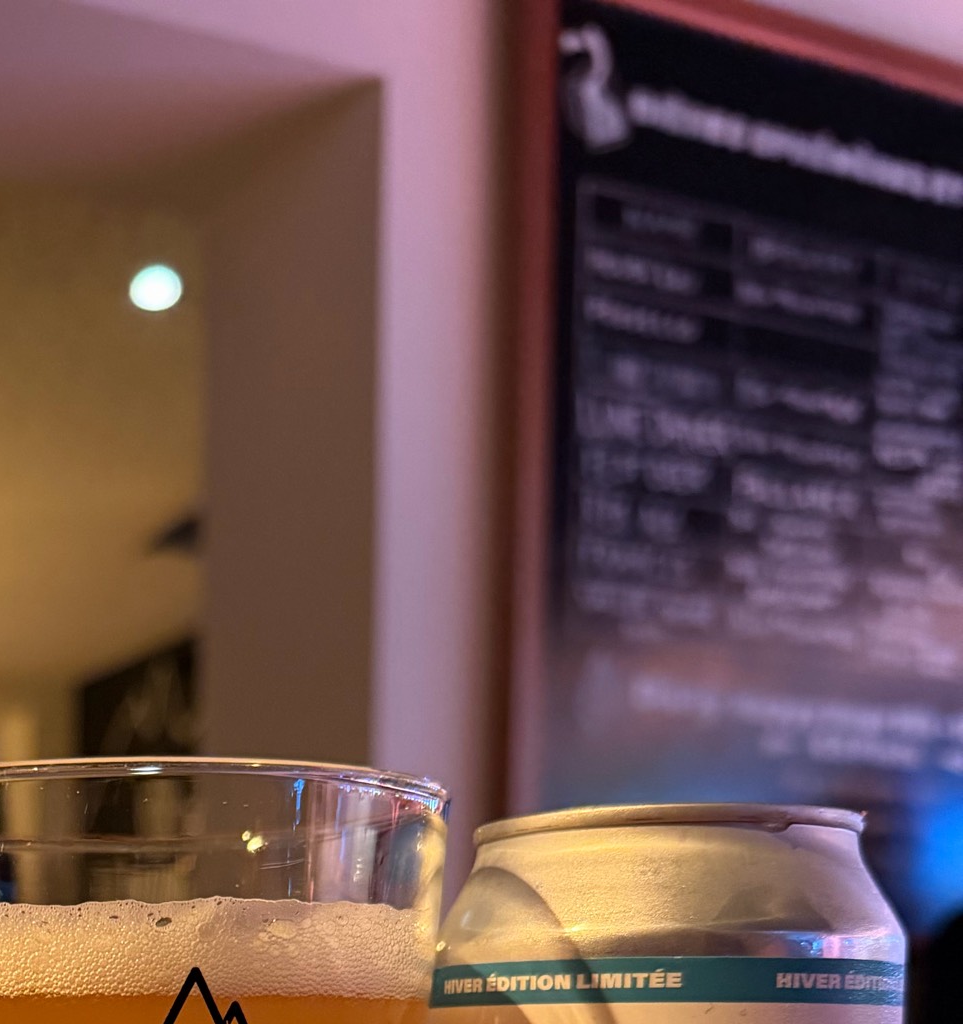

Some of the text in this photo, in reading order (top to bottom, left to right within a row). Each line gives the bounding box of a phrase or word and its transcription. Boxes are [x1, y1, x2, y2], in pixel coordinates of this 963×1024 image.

[444, 968, 683, 995] HIVER ÉDITION LIMITÉE
[776, 972, 842, 989] HIVER
